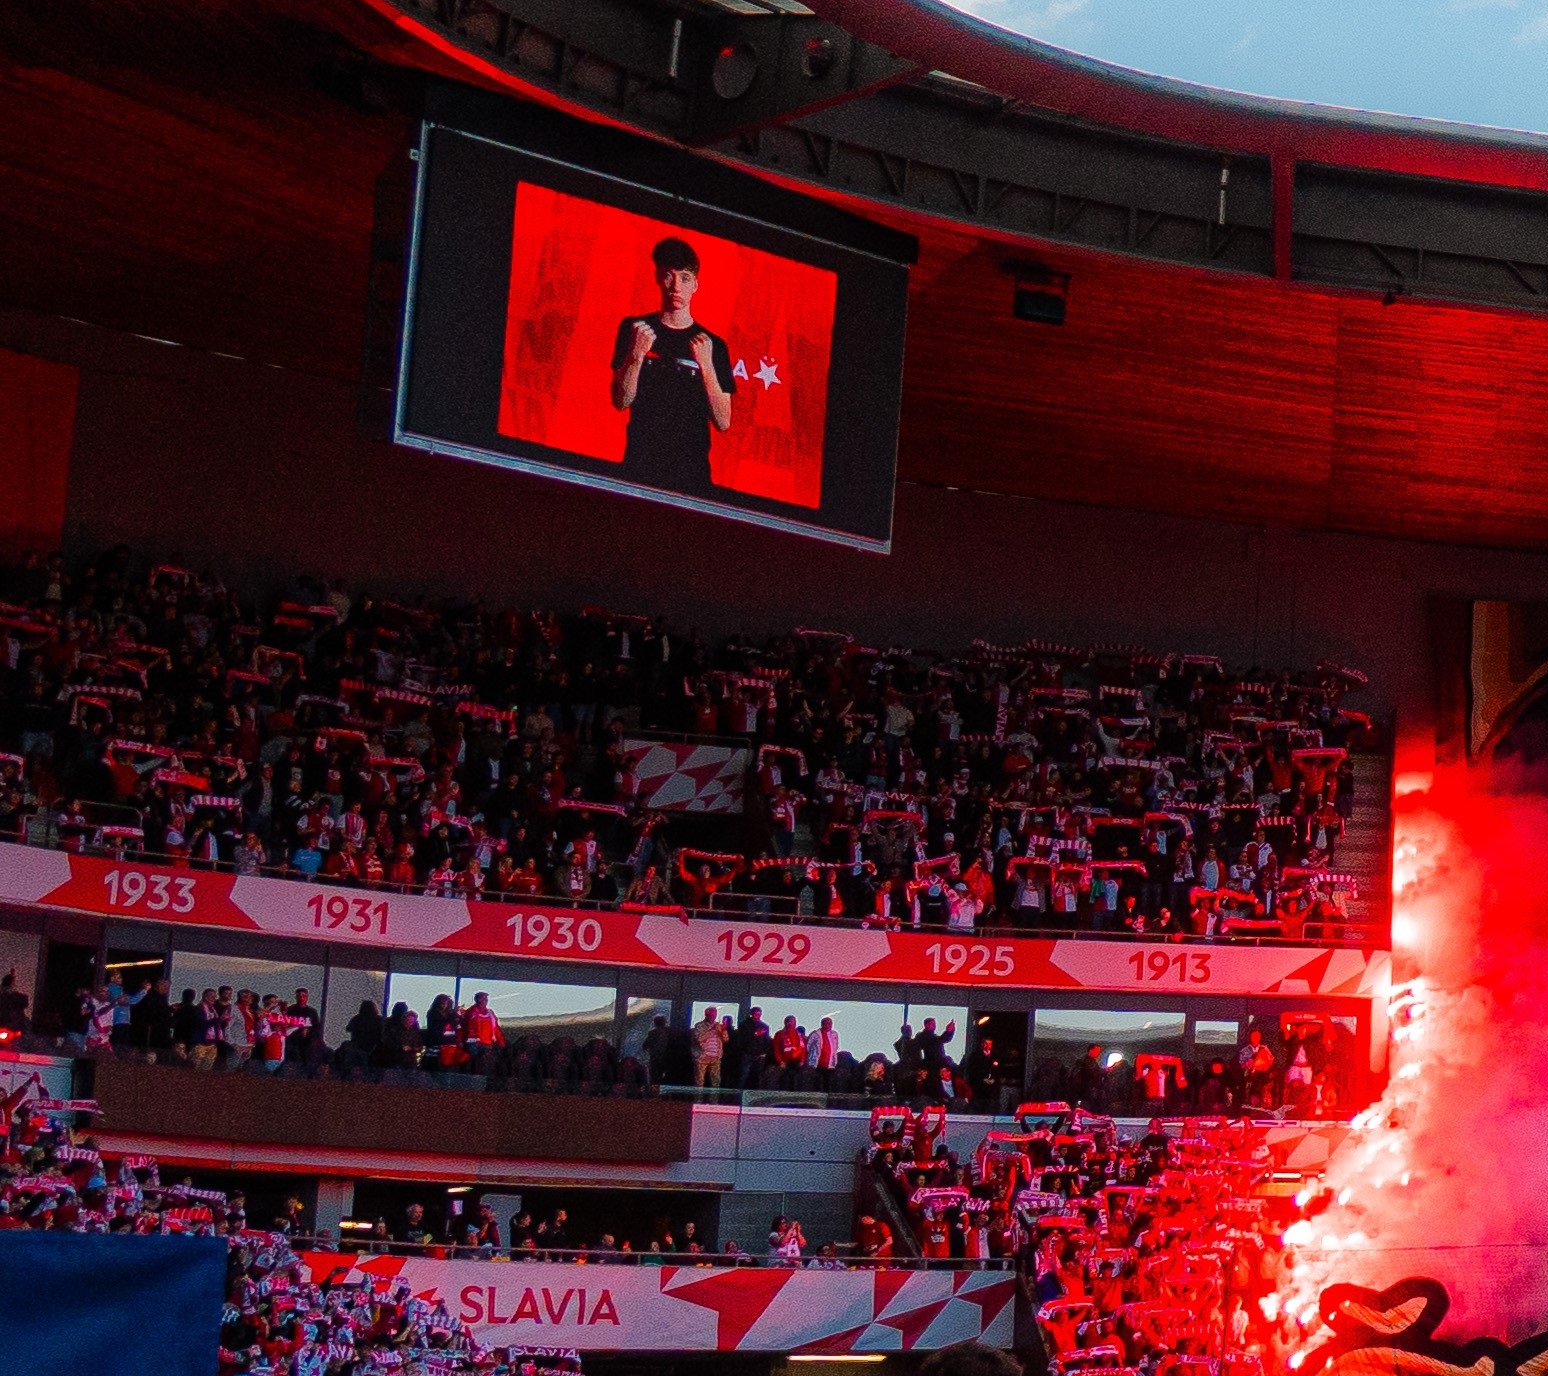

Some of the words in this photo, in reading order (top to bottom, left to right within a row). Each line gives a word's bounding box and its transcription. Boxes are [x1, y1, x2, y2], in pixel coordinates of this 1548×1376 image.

[104, 870, 196, 912] 1933
[307, 894, 389, 935] 1931
[506, 914, 602, 951] 1930
[717, 930, 811, 964] 1929
[925, 943, 1015, 975] 1925
[1128, 951, 1211, 983] 1913
[459, 1285, 620, 1325] SLAVIA
